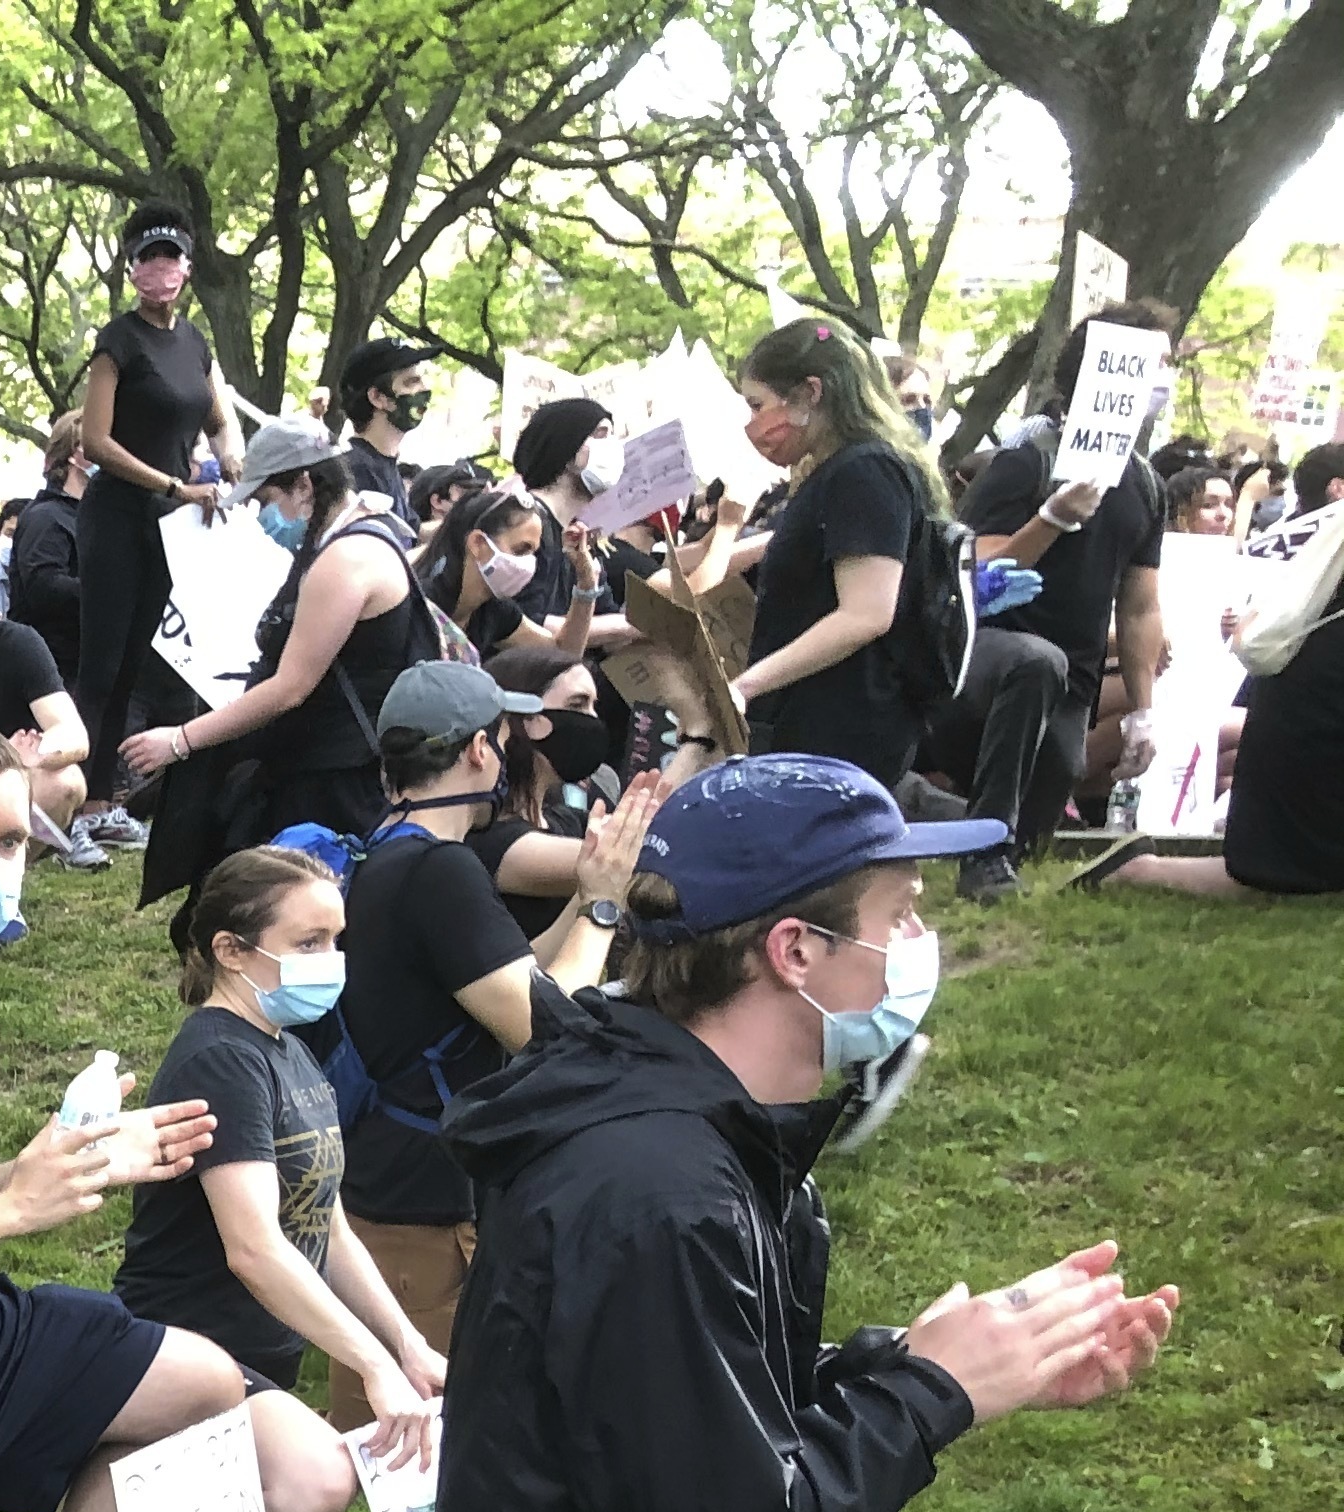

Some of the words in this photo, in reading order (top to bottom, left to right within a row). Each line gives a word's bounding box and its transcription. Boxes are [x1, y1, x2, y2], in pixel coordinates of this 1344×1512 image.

[1097, 350, 1147, 379] BLACK
[1093, 390, 1135, 417] LIVES
[1070, 428, 1132, 456] MATTER
